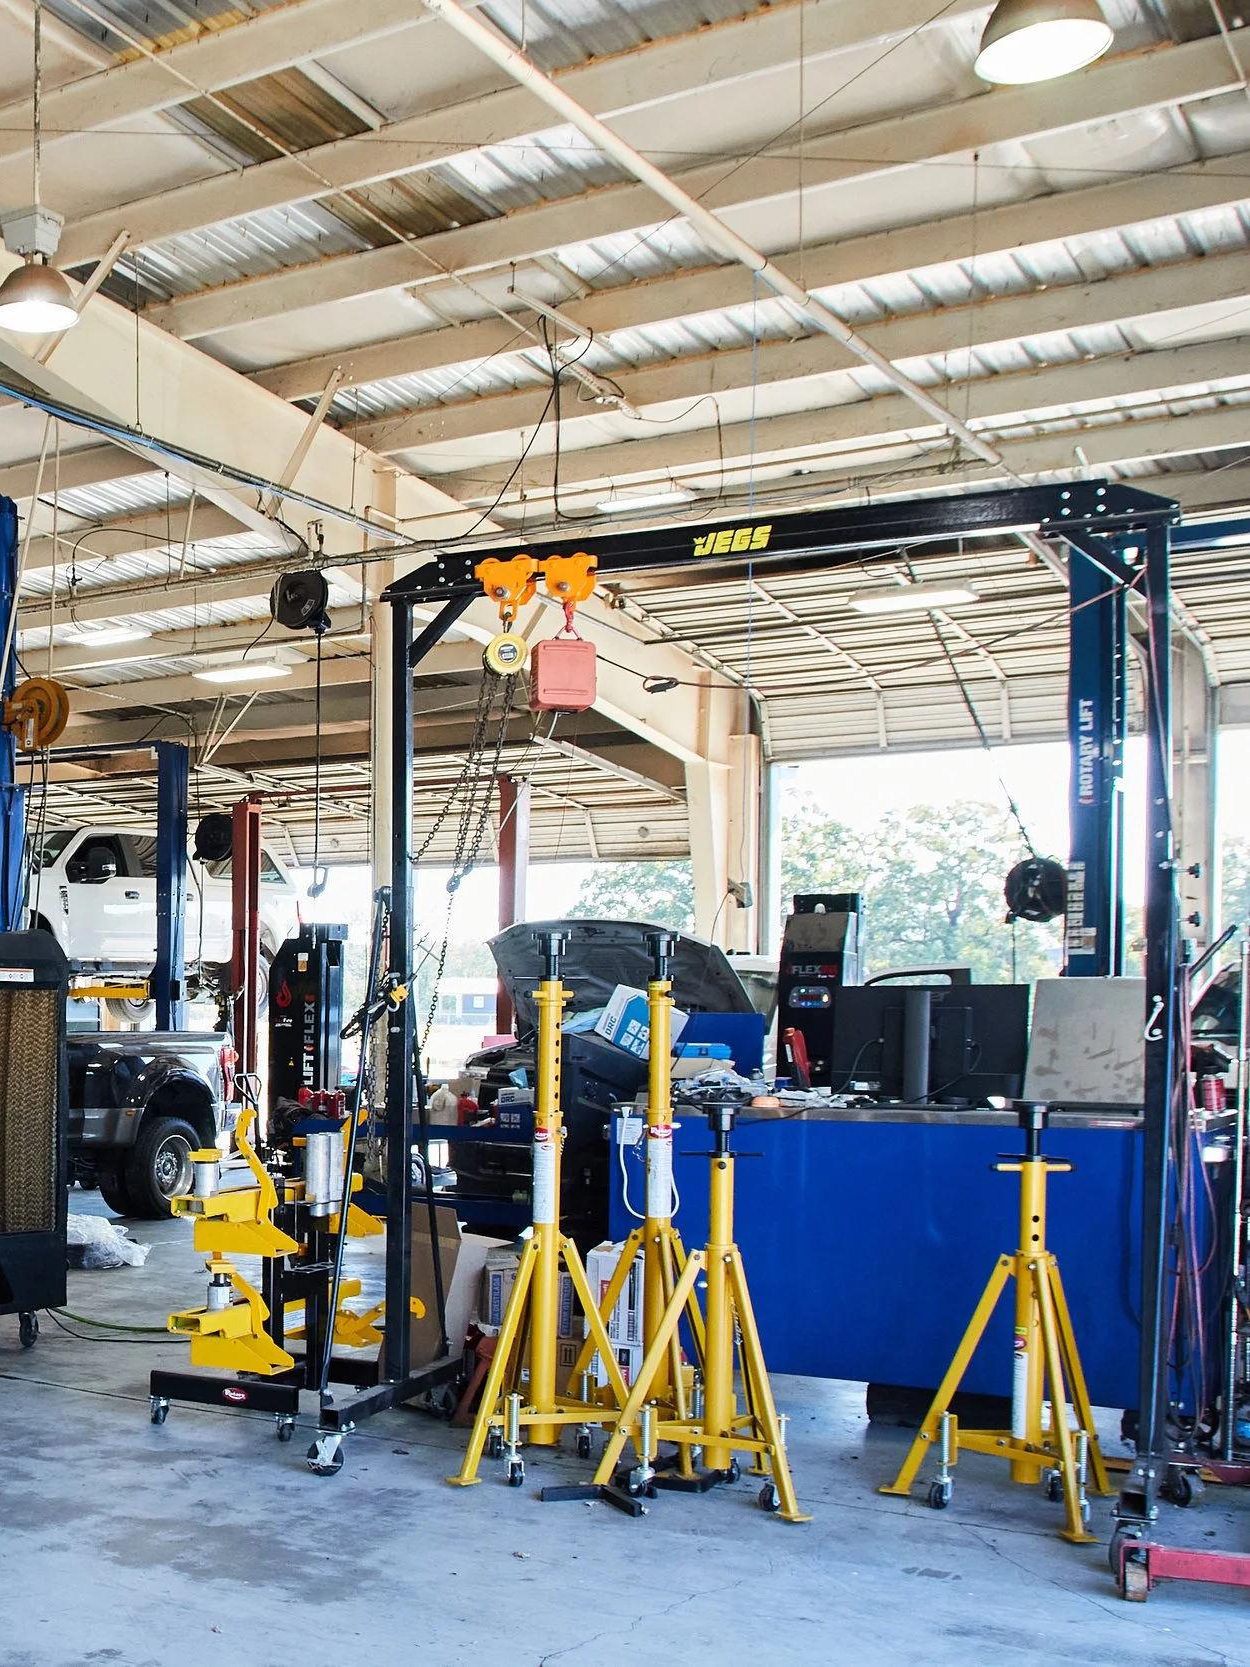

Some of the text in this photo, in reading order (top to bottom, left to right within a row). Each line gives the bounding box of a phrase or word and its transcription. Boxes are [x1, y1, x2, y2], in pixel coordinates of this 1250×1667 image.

[693, 525, 773, 556] JEGS
[1078, 699, 1094, 797] ROTARY LIFT
[302, 1002, 316, 1086] LIFT FLEX
